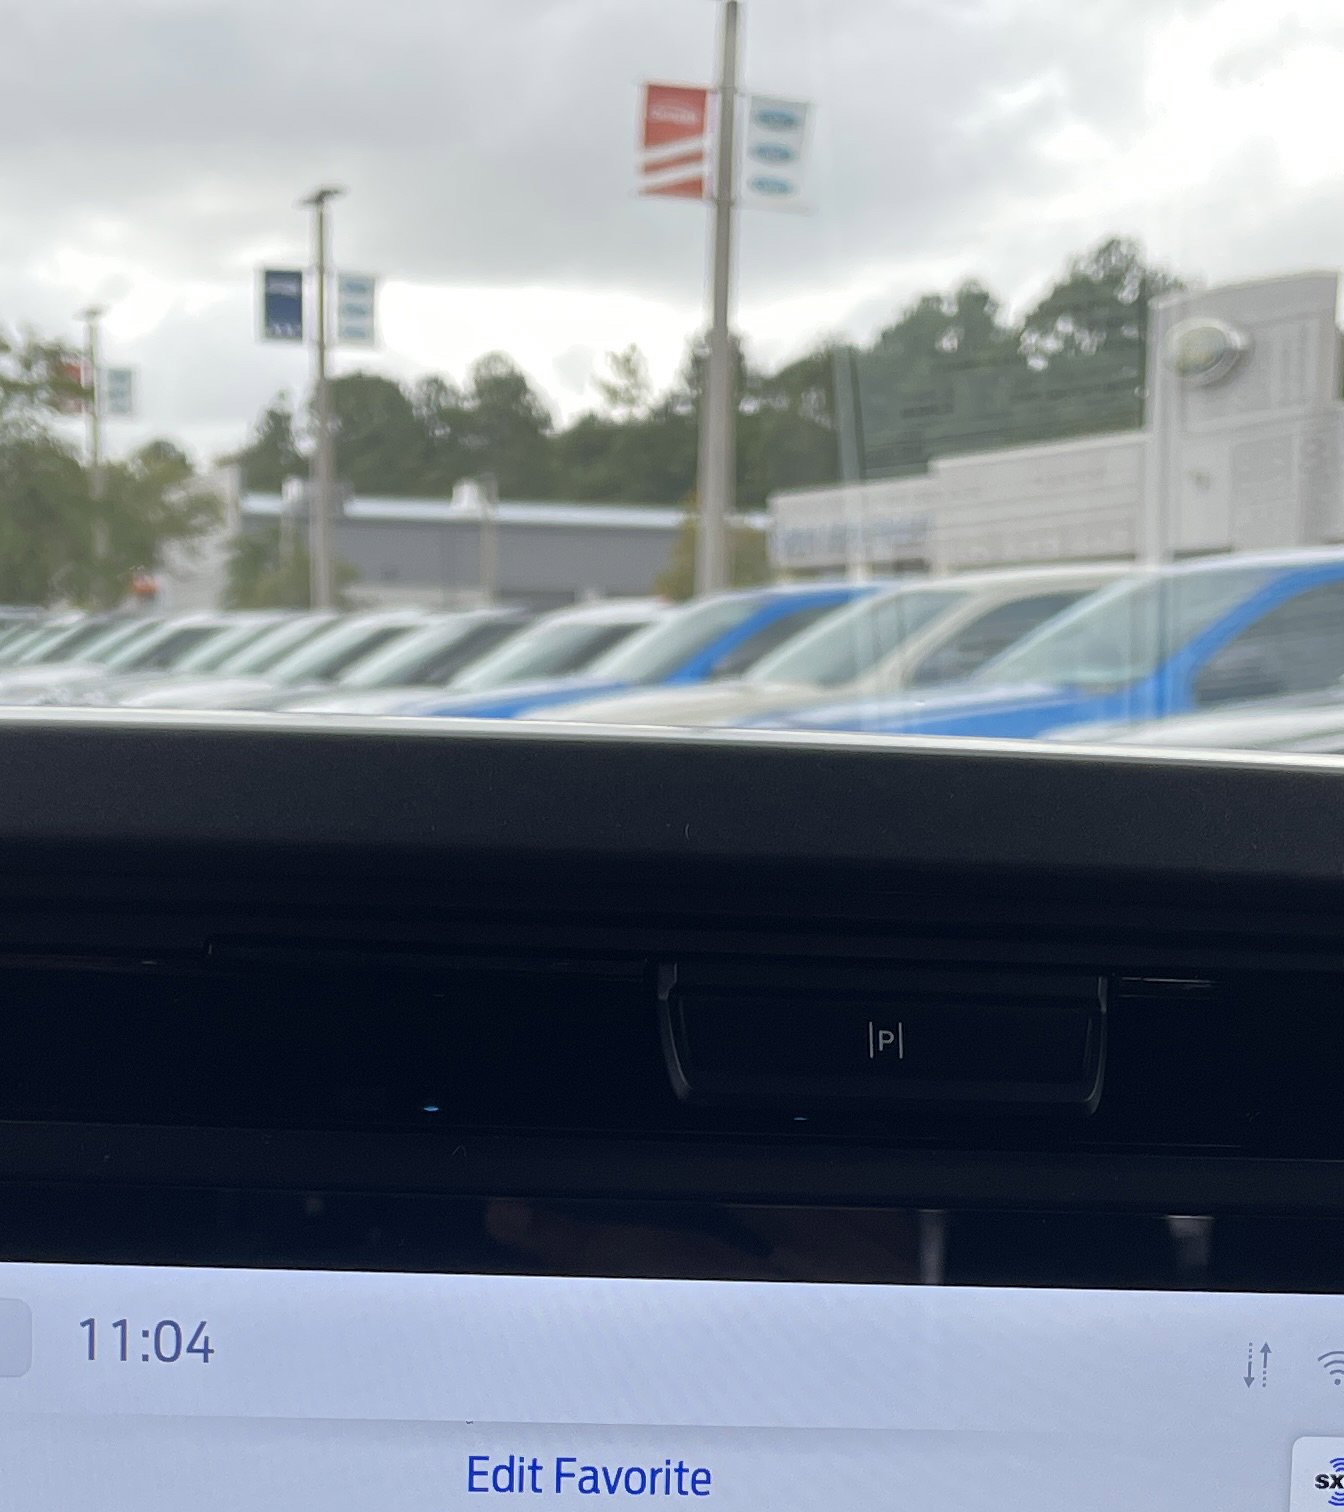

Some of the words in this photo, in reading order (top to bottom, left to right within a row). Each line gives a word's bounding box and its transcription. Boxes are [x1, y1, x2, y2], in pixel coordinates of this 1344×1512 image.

[79, 1317, 215, 1364] 11:04
[467, 1454, 544, 1494] Edit
[555, 1457, 712, 1496] Favorite
